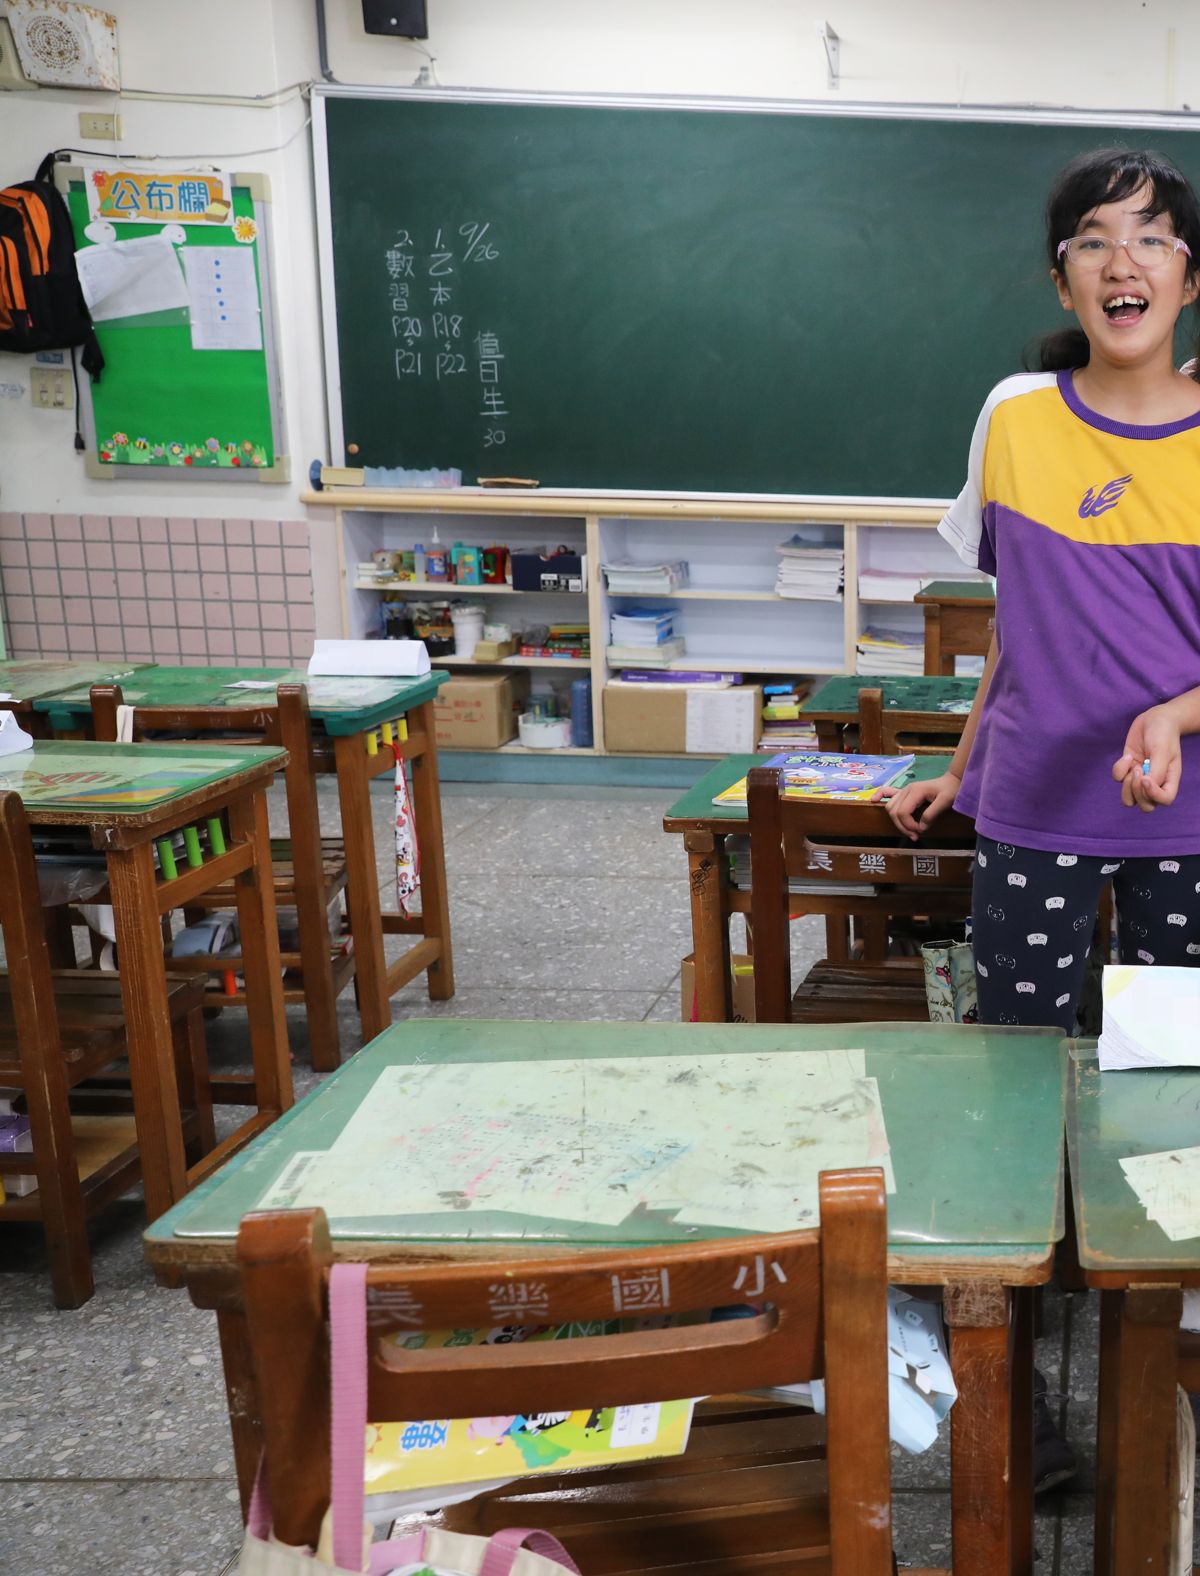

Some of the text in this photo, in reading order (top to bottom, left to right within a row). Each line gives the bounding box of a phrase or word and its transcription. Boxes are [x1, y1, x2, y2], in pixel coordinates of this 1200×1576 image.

[111, 180, 210, 213] 公布欄
[459, 222, 499, 262] 9/26
[473, 329, 510, 416] 值日生
[483, 429, 506, 447] 30
[807, 850, 976, 877] 長樂國
[366, 1254, 788, 1325] 長樂國小
